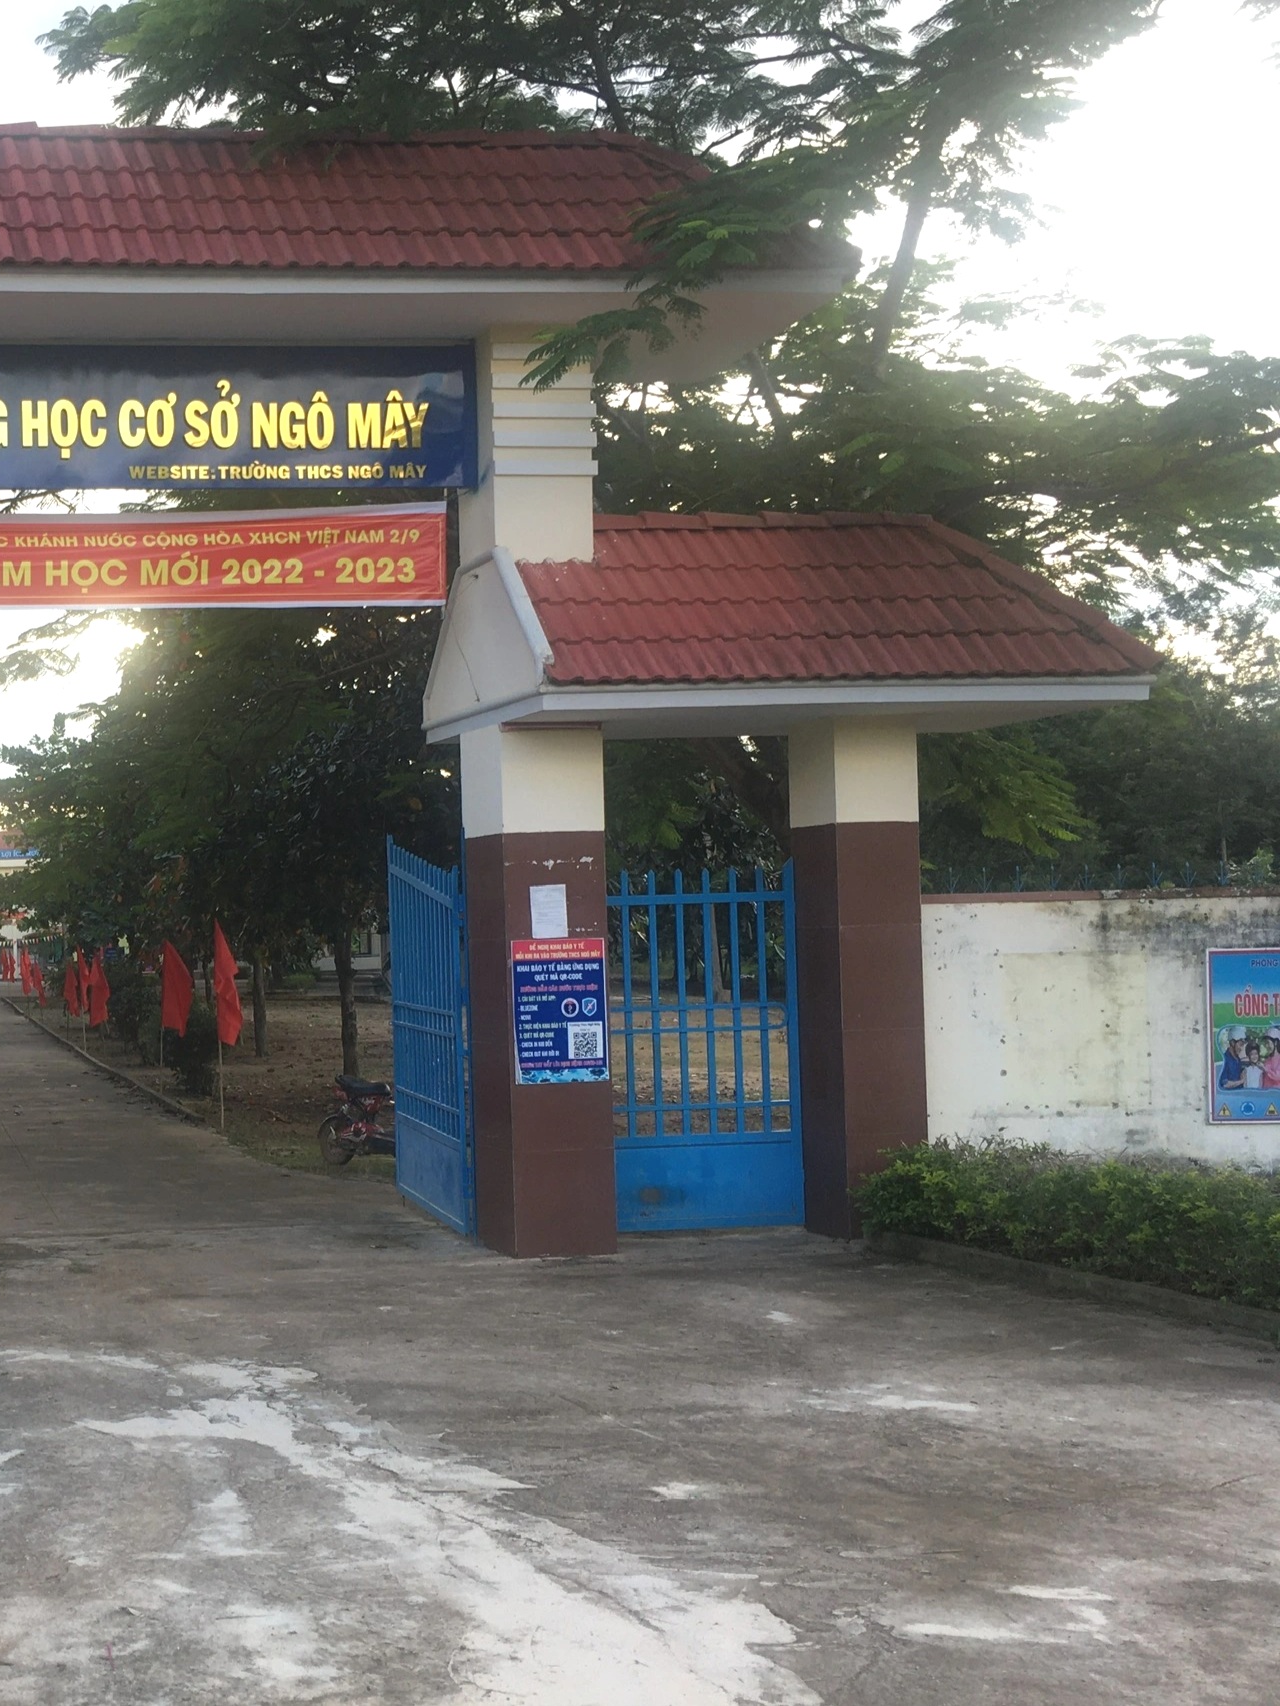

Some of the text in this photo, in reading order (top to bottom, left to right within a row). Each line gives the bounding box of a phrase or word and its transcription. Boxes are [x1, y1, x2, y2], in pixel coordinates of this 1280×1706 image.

[21, 398, 107, 460] HỌC
[118, 392, 177, 449] CƠ
[184, 379, 241, 449] SỞ
[252, 391, 335, 450] NGÔ
[348, 390, 429, 450] MÂY
[295, 465, 343, 479] THCS
[348, 462, 383, 479] NGÔ
[389, 462, 427, 479] MÂY
[14, 532, 79, 548] KHÁNH
[84, 531, 136, 548] NƯỚC
[142, 530, 198, 551] CỘNG
[203, 529, 245, 546] HÒA
[249, 530, 301, 545] XHCN
[305, 528, 340, 549] VIỆT
[344, 529, 384, 545] NAM
[389, 528, 421, 546] 2/9
[45, 559, 128, 594] HỌC
[140, 551, 210, 587] MỚI
[221, 558, 304, 585] 2022
[335, 557, 417, 585] 2023
[1234, 984, 1269, 1017] CỔNG
